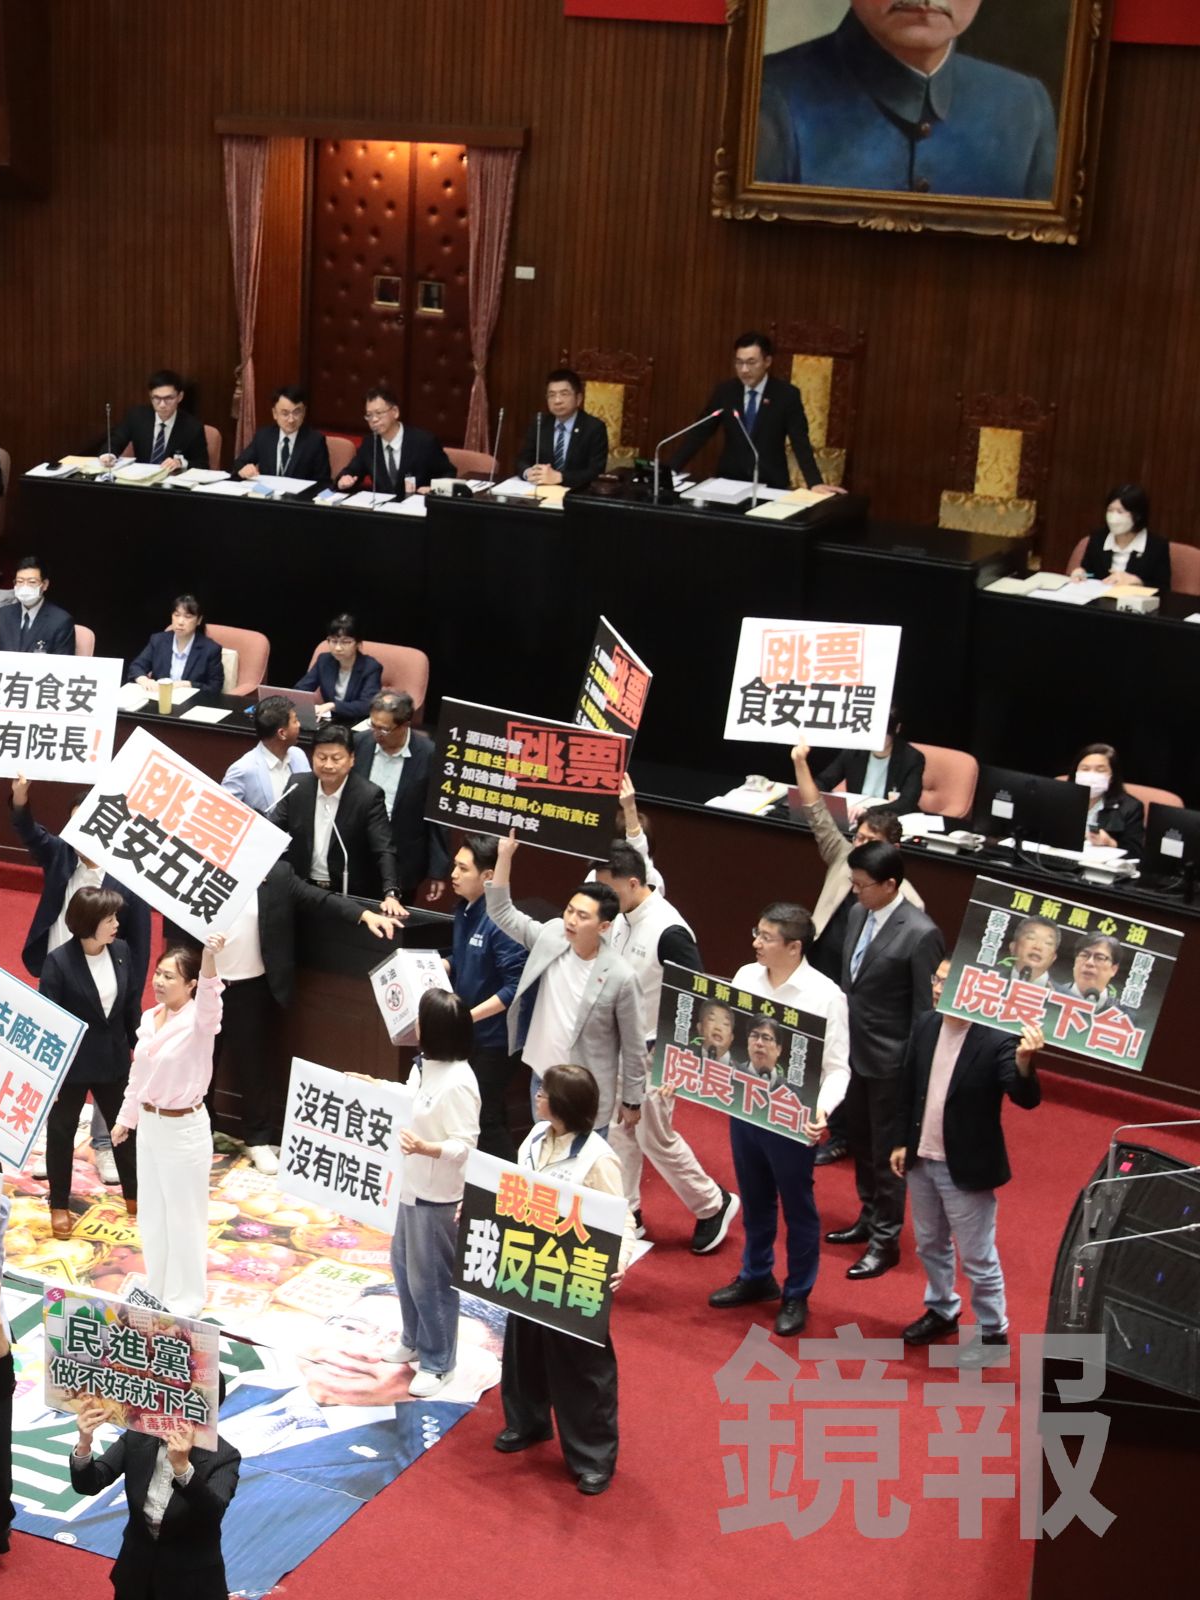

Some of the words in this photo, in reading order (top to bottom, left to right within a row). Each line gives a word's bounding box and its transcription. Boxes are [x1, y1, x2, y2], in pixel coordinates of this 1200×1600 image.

[763, 631, 860, 685] 跳票
[737, 676, 876, 733] 食安五環
[443, 762, 458, 778] 3.
[446, 745, 460, 760] 2.
[127, 762, 251, 862] 跳票
[438, 797, 453, 812] 5.
[455, 800, 540, 832] 全民監督食安
[441, 780, 455, 795] 4.
[79, 793, 239, 925] 食安五環
[1010, 890, 1148, 945] 頂新黑心油
[692, 975, 800, 1027] 頂新黑心油
[952, 964, 1146, 1058] 院長下台!
[294, 1082, 394, 1152] 沒有食安
[286, 1135, 394, 1207] 沒有院長!
[83, 1224, 136, 1241] 小心
[496, 1171, 591, 1245] 我是人
[463, 1218, 610, 1318] 我反台毒
[67, 1316, 191, 1382] 民進黨
[51, 1357, 210, 1423] 做不好就下台
